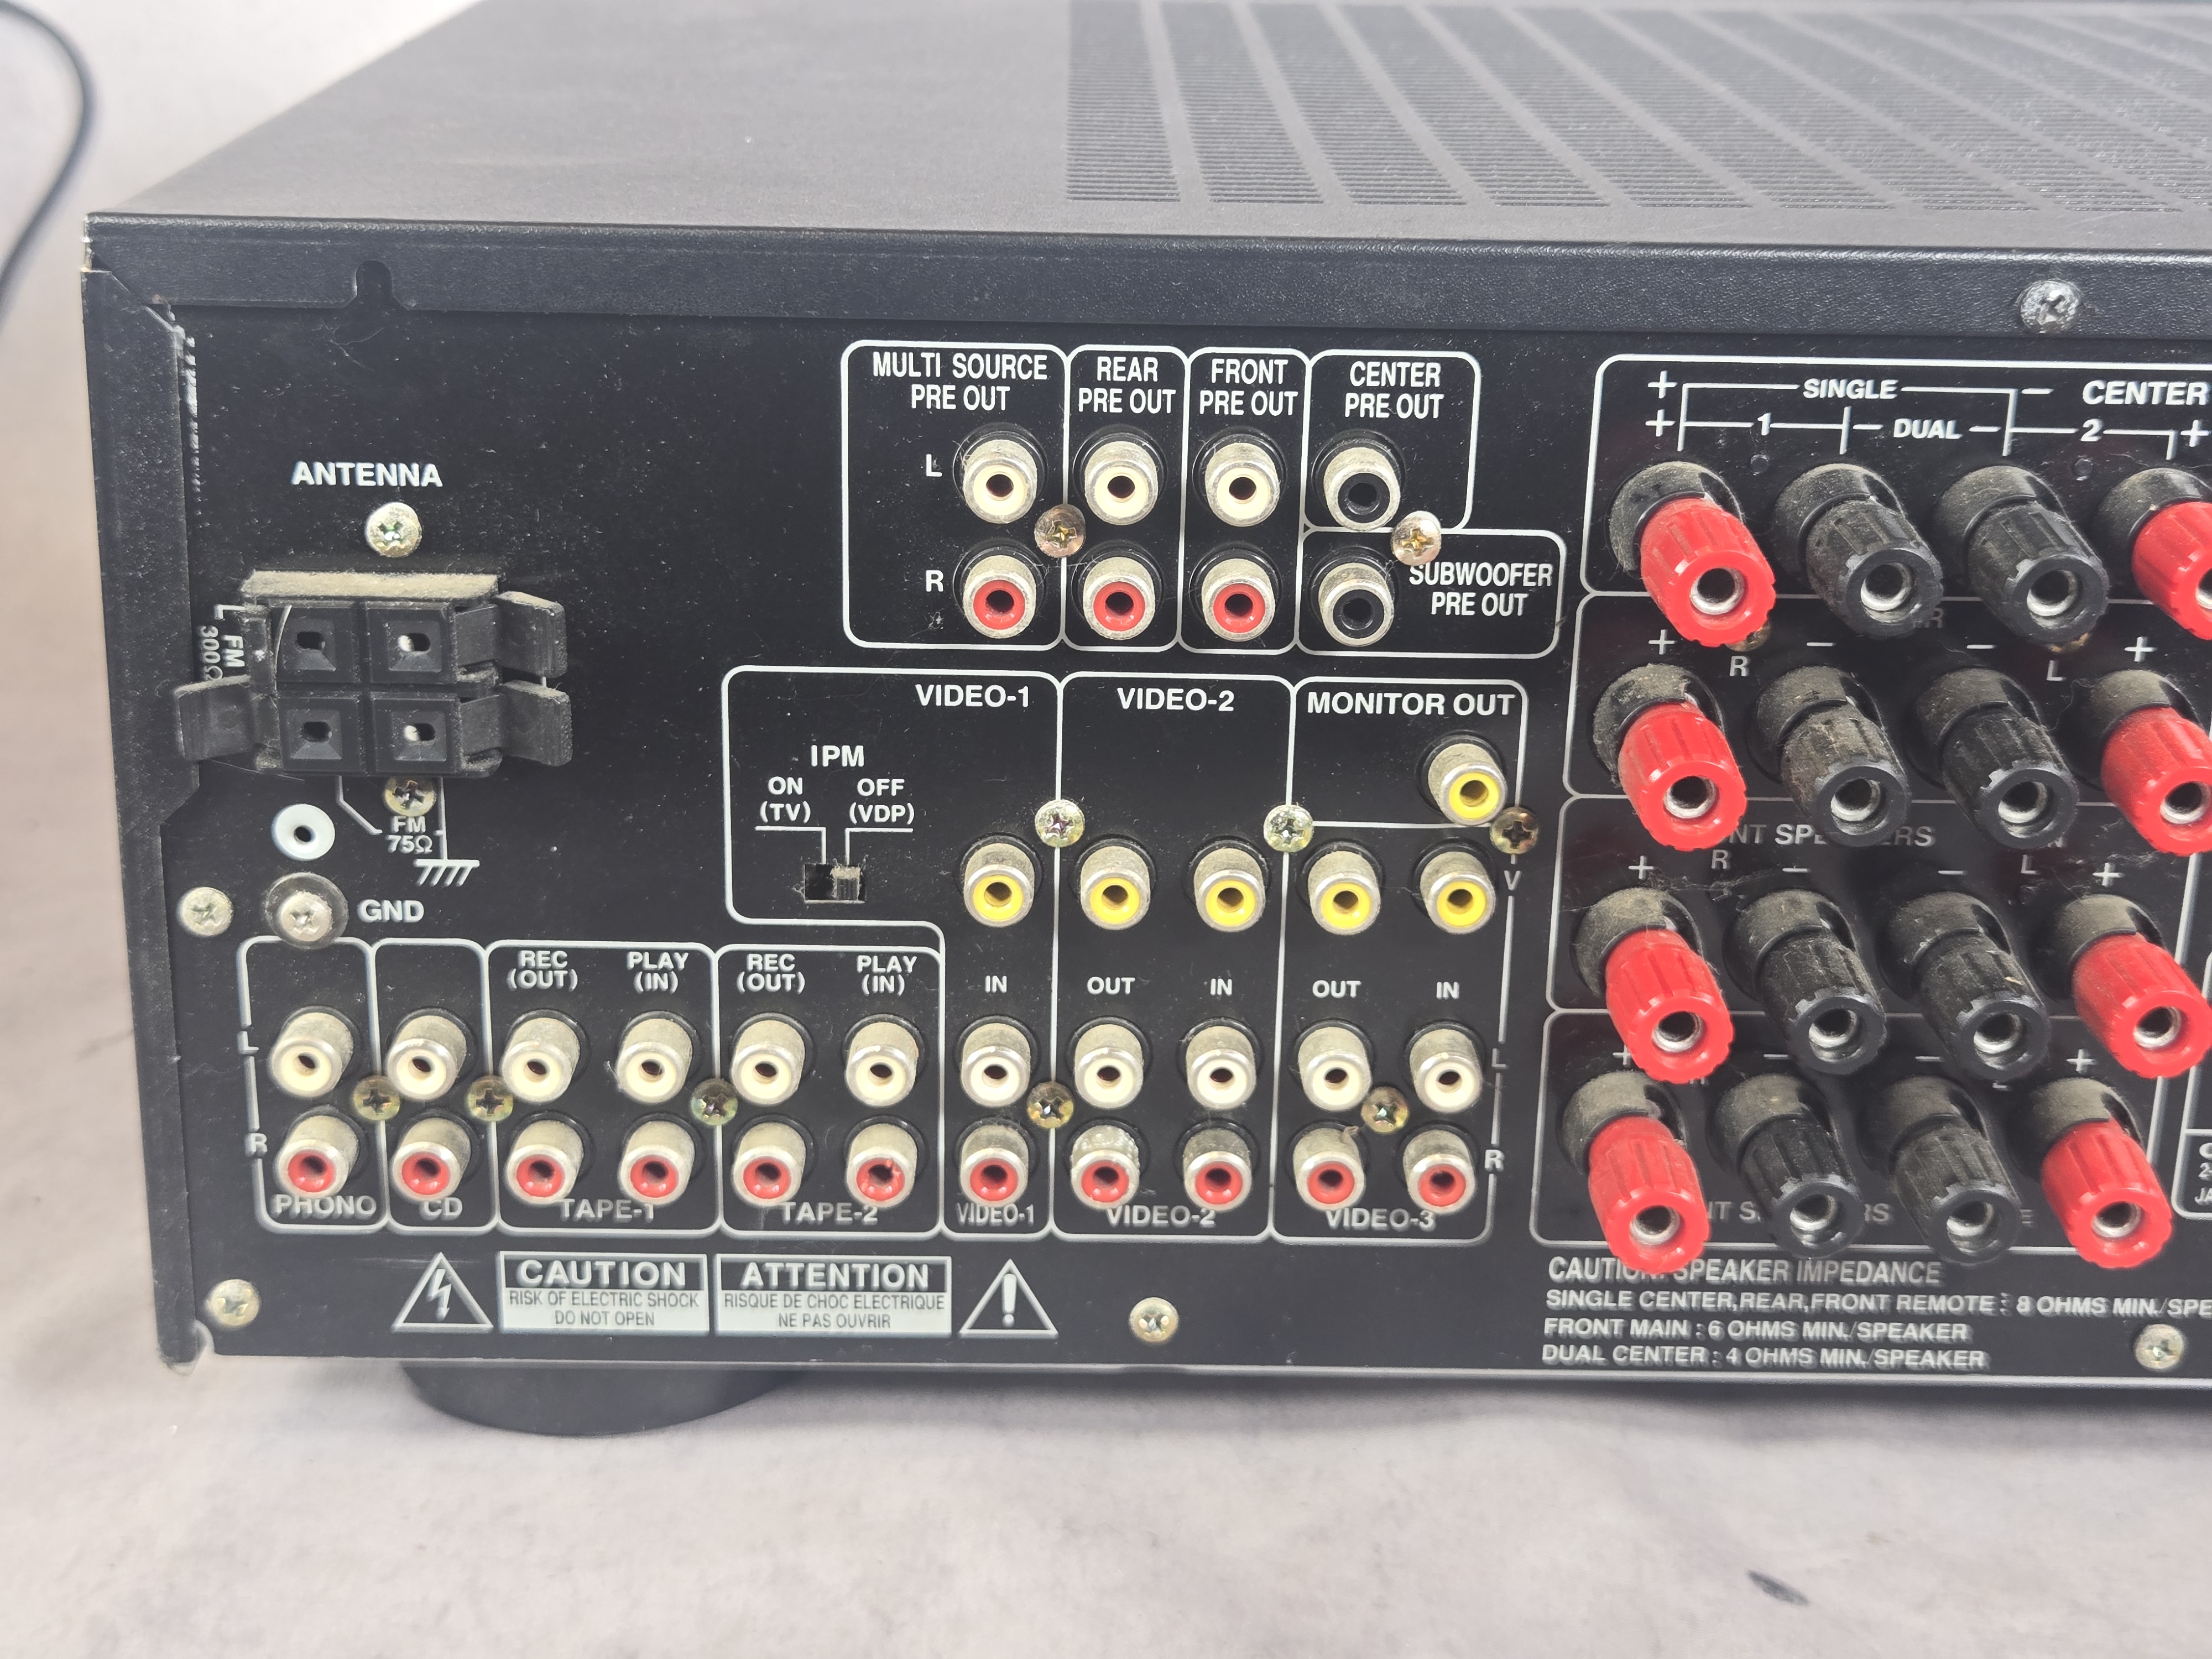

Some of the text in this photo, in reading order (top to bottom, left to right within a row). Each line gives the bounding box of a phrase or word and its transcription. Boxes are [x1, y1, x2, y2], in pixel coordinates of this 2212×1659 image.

[873, 352, 1047, 379] MULTI SOURCE
[1097, 357, 1158, 382] REAR
[1212, 358, 1288, 384] FRONT
[1350, 362, 1441, 387] CENTER
[911, 385, 1010, 410] PRE OUT
[1803, 378, 1898, 399] SINGLE
[2083, 380, 2209, 405] CENTER
[1078, 388, 1176, 414] PRE OUT
[1199, 390, 1298, 416] PRE OUT
[1345, 393, 1444, 419] PRE OUT
[1758, 413, 1771, 436] 1
[1893, 418, 1962, 439] DUAL
[2081, 419, 2103, 442] 2
[291, 461, 442, 487] ANTENNA
[926, 454, 942, 477] L
[926, 570, 943, 592] R
[1409, 562, 1553, 586] SUBWOOFER
[1431, 592, 1528, 617] PRE OUT
[224, 635, 245, 667] FM
[1729, 656, 1748, 677] R
[2047, 660, 2064, 681] L
[916, 684, 1029, 707] VIDEO-1
[1117, 687, 1234, 712] VIDEO-2
[1308, 692, 1515, 716] MONITOR OUT
[811, 745, 864, 767] IPM
[768, 777, 803, 795] ON
[857, 779, 904, 796] OFF
[760, 801, 811, 822] (TV)
[849, 802, 914, 824] (VDP)
[394, 816, 425, 832] FM
[1775, 824, 1933, 847] SPRS
[1712, 849, 1729, 869] R
[2021, 854, 2036, 874] L
[1504, 870, 1521, 890] V
[361, 900, 424, 922] GND
[519, 951, 567, 968] REC
[629, 952, 688, 969] PLAY
[748, 954, 795, 971] REC
[858, 956, 917, 972] PLAY
[510, 968, 577, 989] (OUT)
[637, 972, 679, 992] (IN)
[738, 972, 805, 993] (OUT)
[862, 974, 905, 995] (IN)
[985, 975, 1007, 993] IN
[1087, 977, 1135, 994] OUT
[1211, 979, 1232, 995] IN
[1313, 980, 1360, 998] OUT
[1437, 982, 1459, 999] IN
[1492, 1048, 1507, 1068] L
[248, 1134, 267, 1152] R
[1485, 1150, 1503, 1169] R
[276, 1195, 376, 1215] PHONO
[423, 1197, 462, 1216] CD
[561, 1199, 654, 1218] TAPE-1
[781, 1202, 877, 1221] TAPE-2
[956, 1203, 1034, 1223] VIDEO-1
[1107, 1206, 1215, 1225] VIDEO-2
[1326, 1208, 1436, 1228] VIDEO-3
[519, 1259, 685, 1285] CAUTION
[742, 1262, 928, 1288] ATTENTION
[1673, 1259, 1788, 1281] SPEAKER
[1797, 1260, 1942, 1284] IMPEDANCE
[509, 1291, 700, 1308] RISK OF ELECTRIC SHOCK
[724, 1293, 945, 1310] RISQUE DE CHOC ELECTRIQUE
[1547, 1290, 1631, 1308] SINGLE
[1897, 1295, 1993, 1312] REMOTE
[2016, 1296, 2029, 1312] 8
[2037, 1296, 2106, 1314] OHMS
[555, 1310, 655, 1326] DO NOT OPEN
[779, 1313, 890, 1328] NE PAS OUVRIR
[1544, 1318, 1624, 1335] FRONT
[1630, 1319, 1687, 1335] MAIN
[1708, 1320, 1721, 1337] 6
[1728, 1320, 1795, 1338] OHMS
[1542, 1345, 1605, 1362] DUAL
[1613, 1345, 1705, 1363] CENTER
[1726, 1347, 1737, 1363] 4
[1745, 1347, 1813, 1365] OHMS
